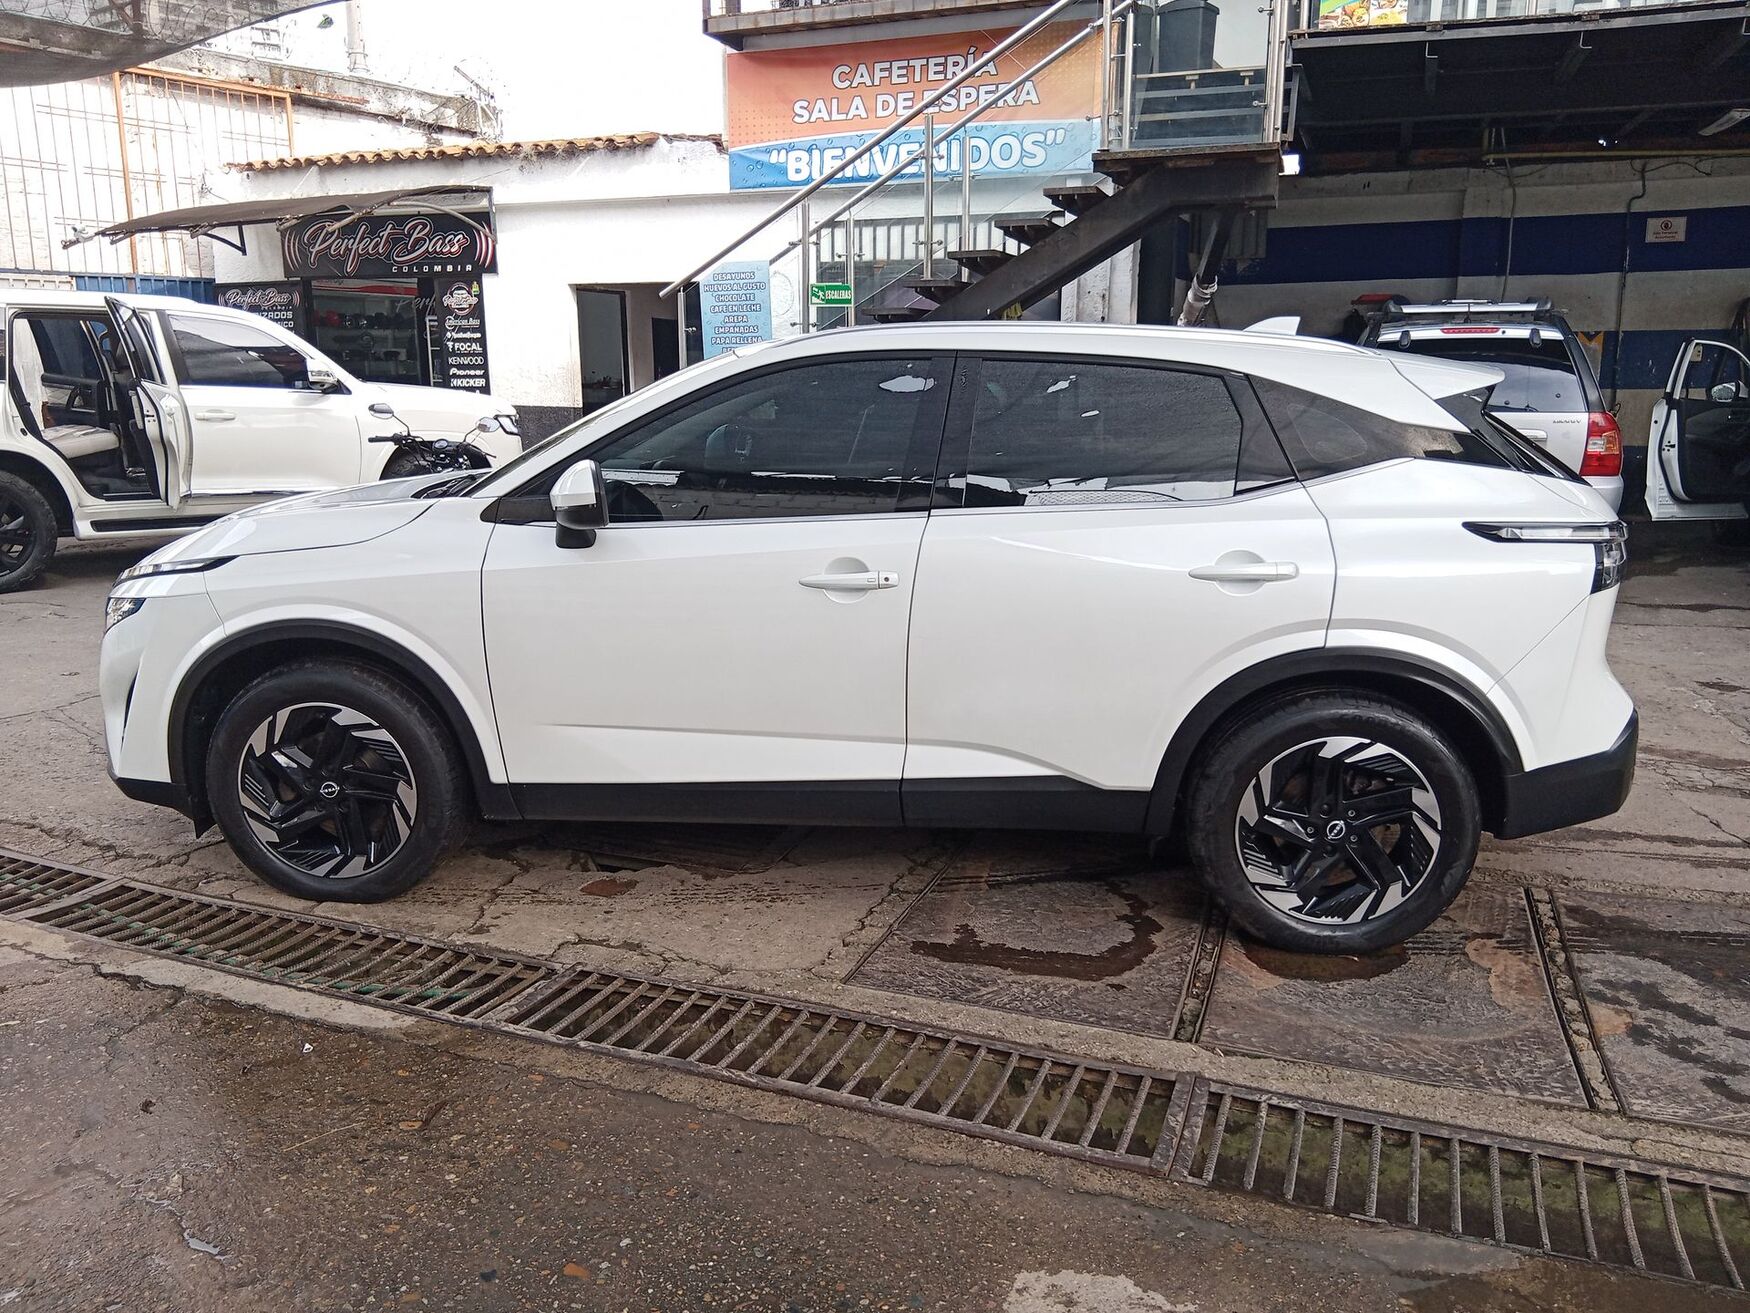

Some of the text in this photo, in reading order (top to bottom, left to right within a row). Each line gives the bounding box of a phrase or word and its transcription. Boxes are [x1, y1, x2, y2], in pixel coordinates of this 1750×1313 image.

[832, 45, 998, 90] CAFETERÍA
[792, 79, 1040, 124] SALA DE ESPERA
[304, 216, 470, 276] Perfect Bass
[392, 264, 473, 273] COLOMBIA
[713, 271, 755, 281] DESAYUNOS
[704, 282, 766, 292] HUEVOS AL GUSTO
[225, 288, 292, 310] Perfect Bass
[715, 293, 755, 302] CHOCOLATE
[825, 290, 852, 299] ESCALERAS
[710, 303, 761, 313] CAFE EN LECHE
[724, 315, 748, 323] AREPA
[714, 325, 759, 334] EMPANADAS
[711, 335, 763, 345] PAPA RELLENA
[455, 342, 483, 351] FOCAL
[448, 356, 485, 365] KENWOOD
[450, 367, 485, 375] Pioneer
[457, 378, 486, 387] KICKER
